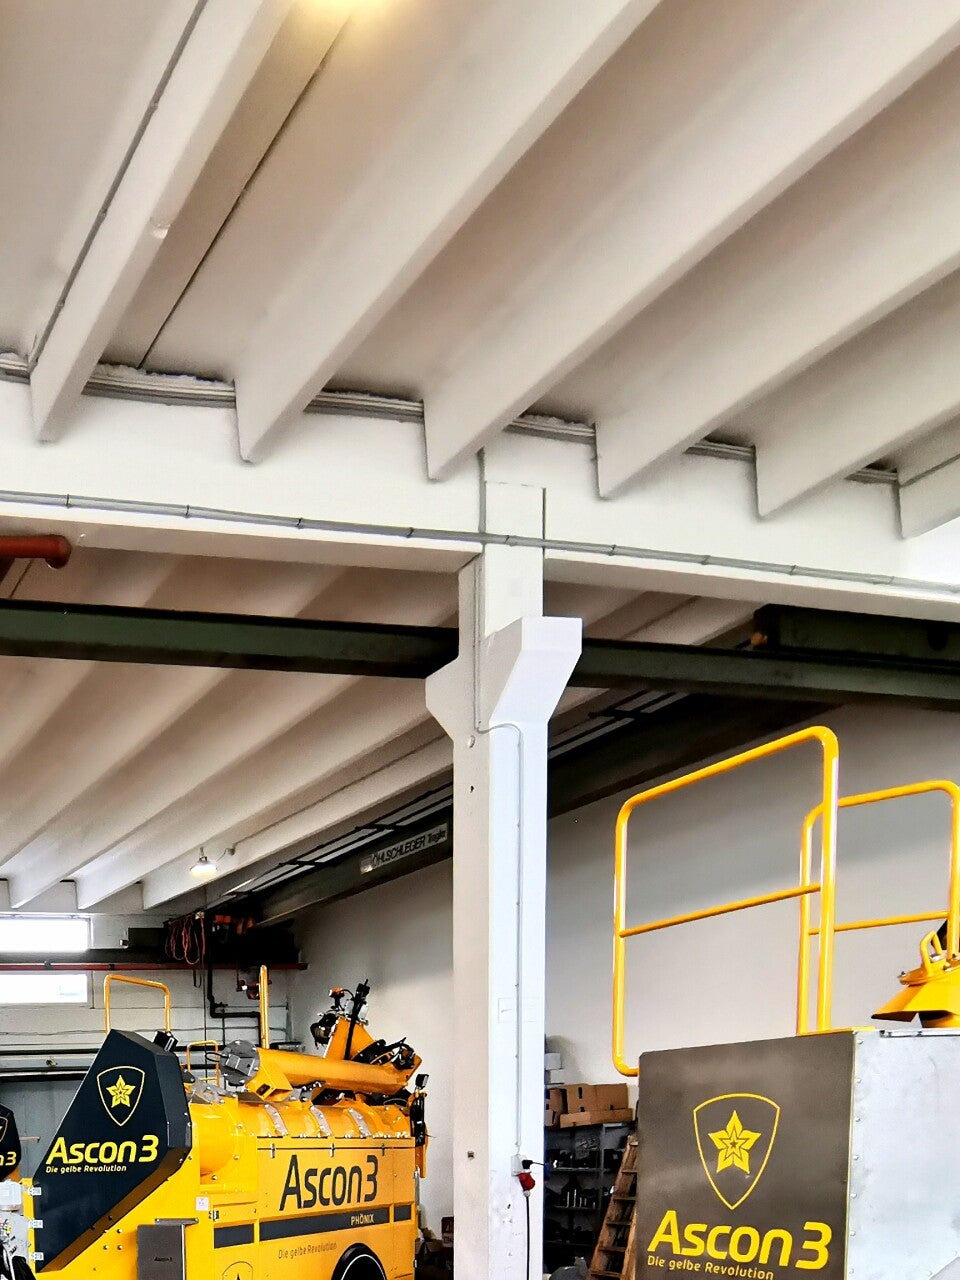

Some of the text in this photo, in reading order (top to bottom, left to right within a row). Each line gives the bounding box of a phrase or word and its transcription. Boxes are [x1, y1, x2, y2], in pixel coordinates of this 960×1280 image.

[45, 1164, 127, 1174] Die gelbe Revolution
[647, 1255, 775, 1280] Die gelbe Revolution
